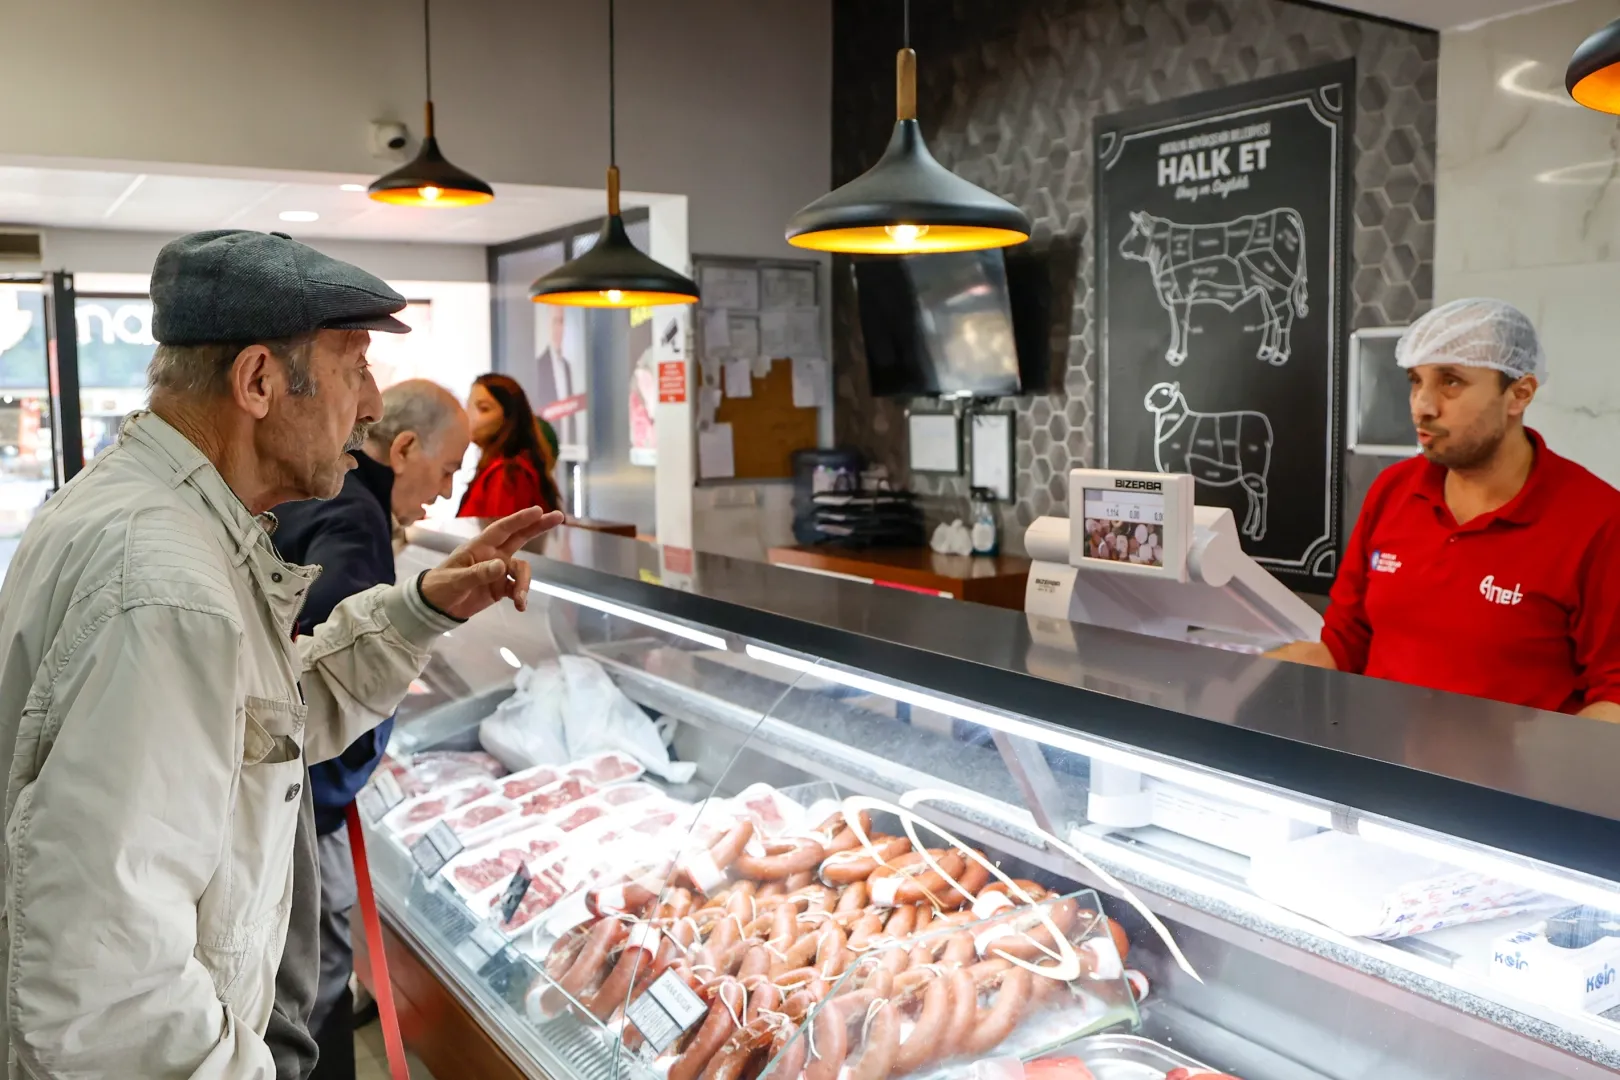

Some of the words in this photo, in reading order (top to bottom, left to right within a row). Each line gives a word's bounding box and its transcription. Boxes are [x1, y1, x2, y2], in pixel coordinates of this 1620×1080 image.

[1157, 146, 1231, 187] HALK
[1239, 139, 1271, 173] ET
[1114, 479, 1162, 491] BIZERBA
[1479, 574, 1524, 606] Anet
[1586, 962, 1616, 993] Koin
